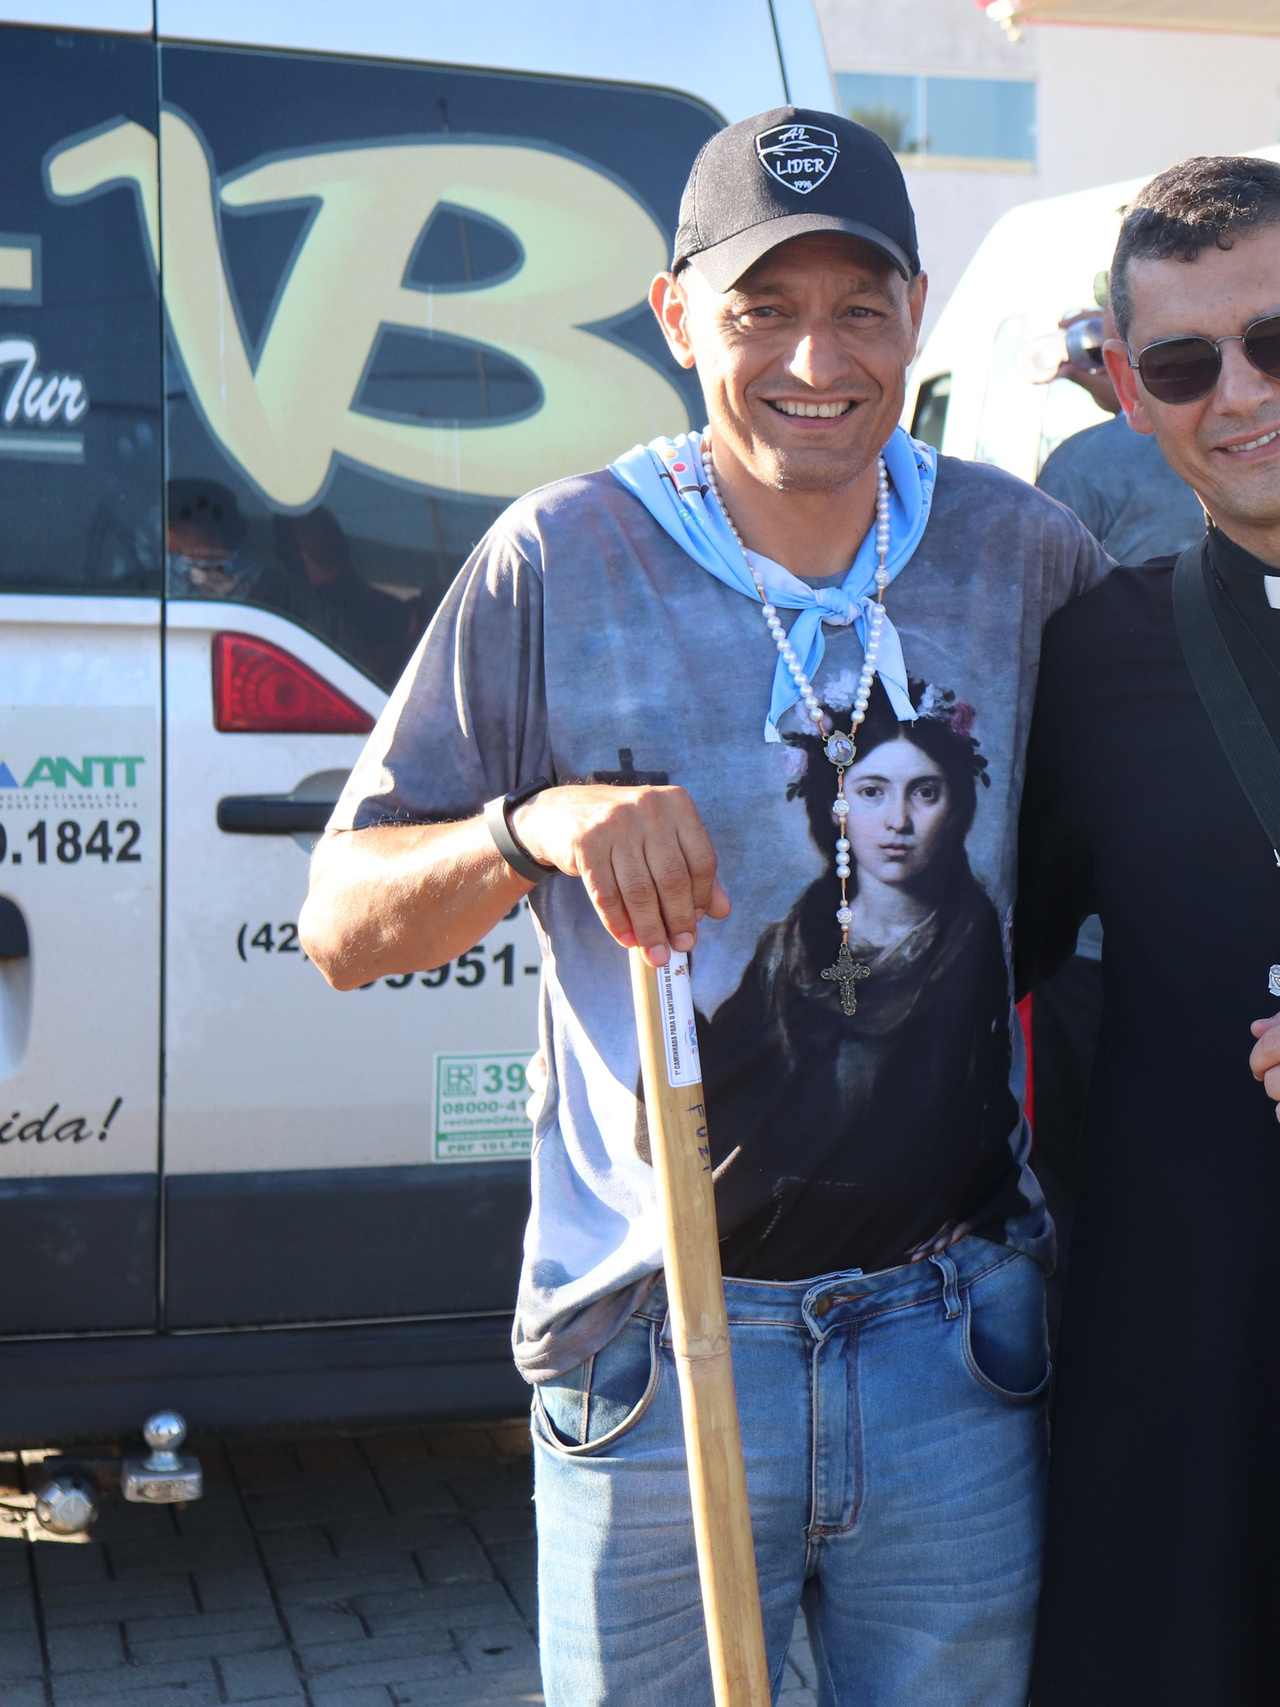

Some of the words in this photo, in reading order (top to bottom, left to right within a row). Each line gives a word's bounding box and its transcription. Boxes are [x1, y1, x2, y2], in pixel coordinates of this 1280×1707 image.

[776, 158, 827, 175] LIDER
[0, 338, 88, 422] Tur
[22, 755, 148, 789] ANTT
[236, 921, 309, 963] (42
[483, 1062, 533, 1094] 39
[0, 1096, 123, 1146] ida!
